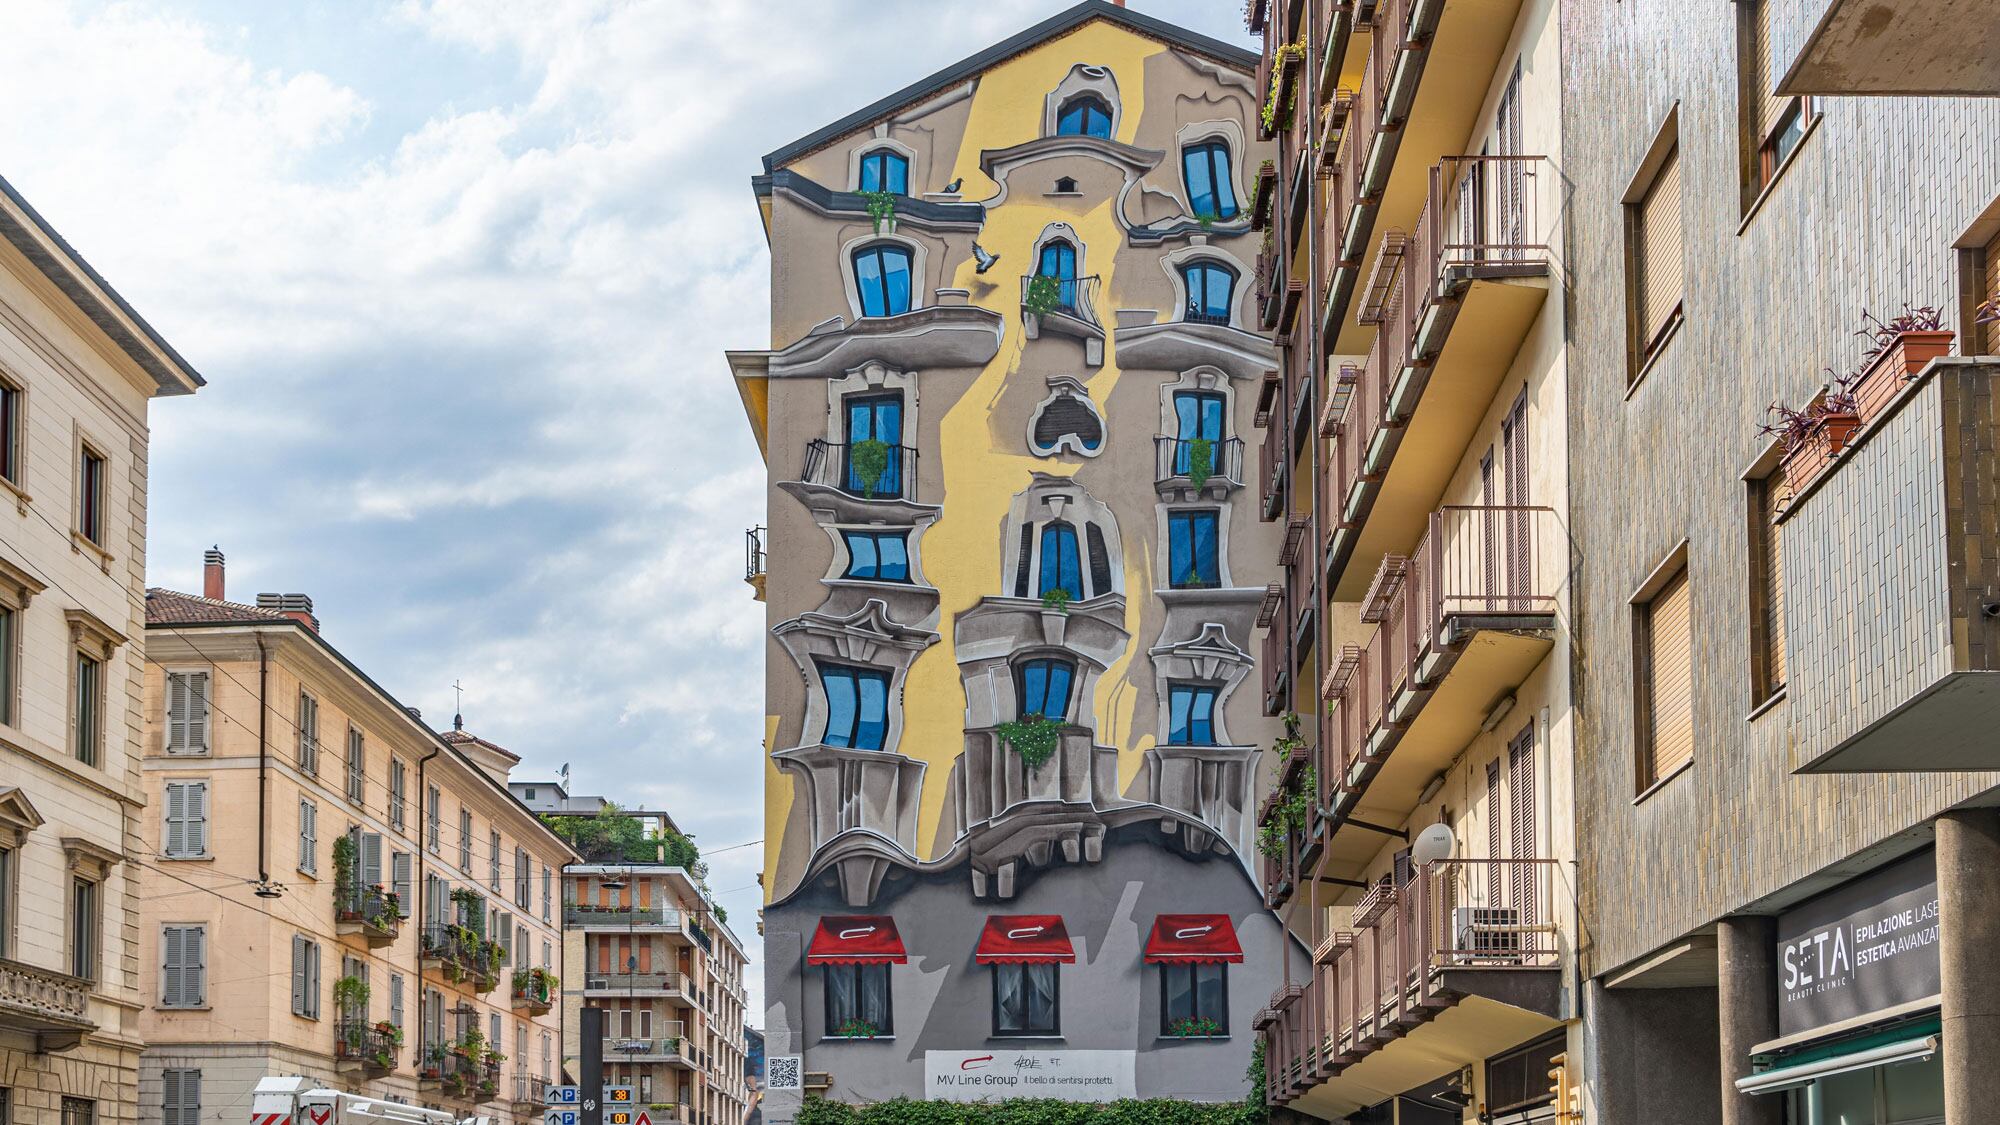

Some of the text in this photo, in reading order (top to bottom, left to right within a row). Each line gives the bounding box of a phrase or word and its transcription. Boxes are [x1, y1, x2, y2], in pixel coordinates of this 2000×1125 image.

[1856, 910, 1912, 943] EPILAZIONE
[1784, 927, 1849, 990] SETA
[1857, 940, 1897, 967] ESTETICA
[1788, 977, 1846, 1002] BEAUTY CLINIC
[937, 1074, 1018, 1087] MV Line Group
[1029, 1076, 1048, 1084] bello
